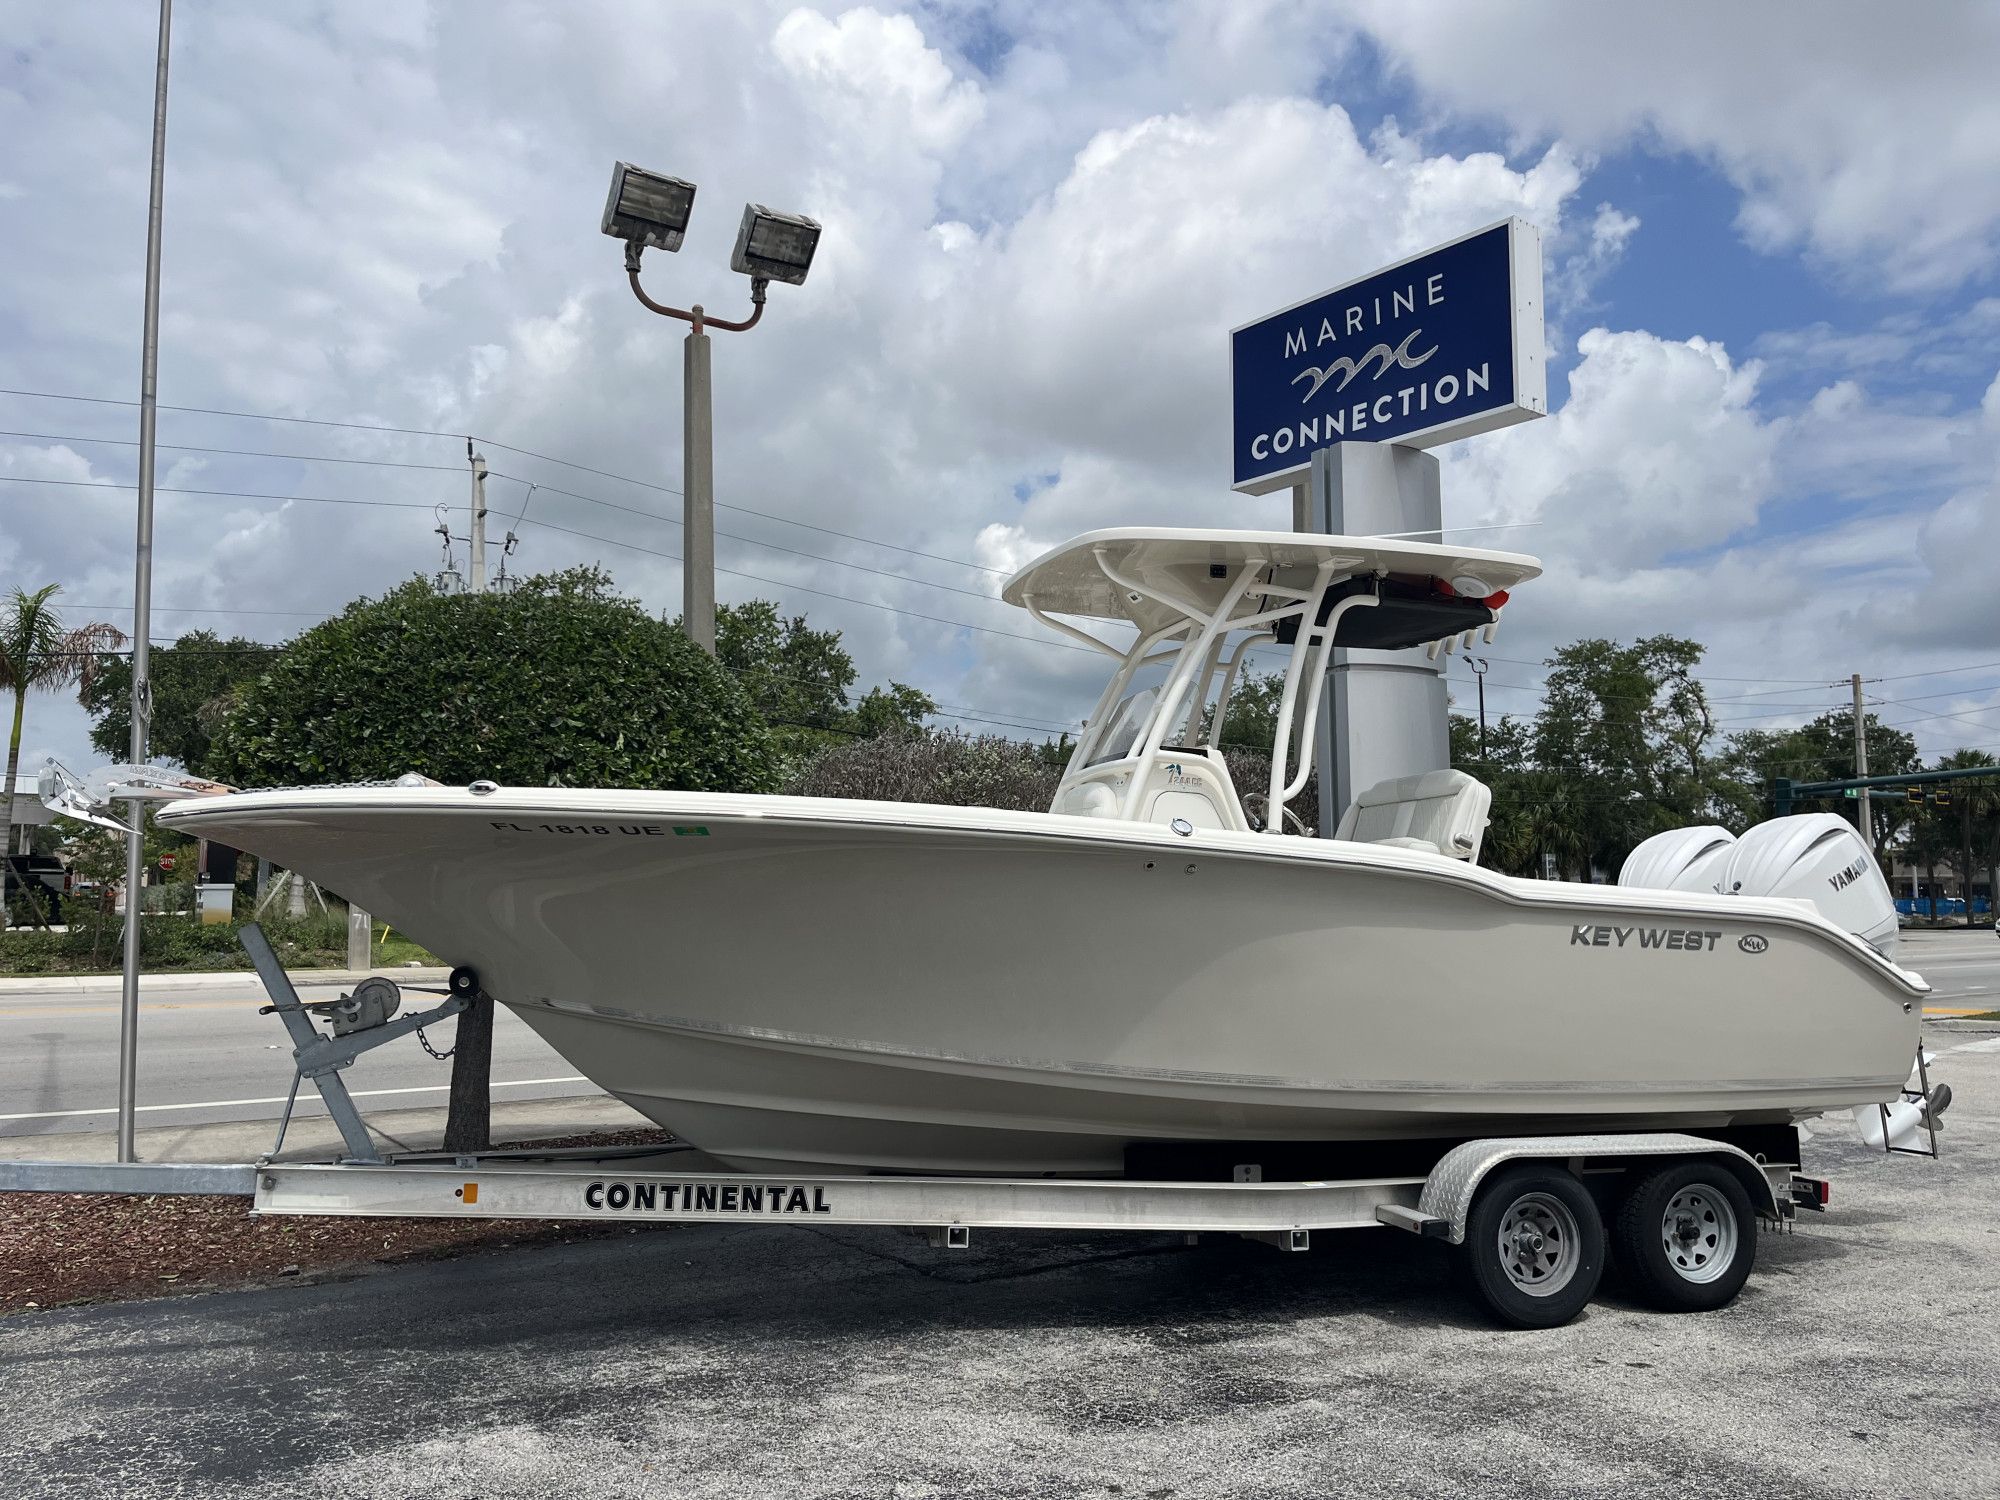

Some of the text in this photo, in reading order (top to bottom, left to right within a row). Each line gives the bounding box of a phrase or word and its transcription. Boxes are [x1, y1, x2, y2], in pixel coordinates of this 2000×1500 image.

[1284, 273, 1445, 358] MARINE
[1250, 362, 1490, 460] CONNECTION
[489, 822, 665, 836] FL 1818 UE
[1828, 855, 1869, 892] YAMAHA
[353, 913, 368, 929] 71
[1570, 925, 1635, 947] KEY
[1638, 928, 1722, 951] WEST
[584, 1182, 831, 1214] CONTINENTAL
